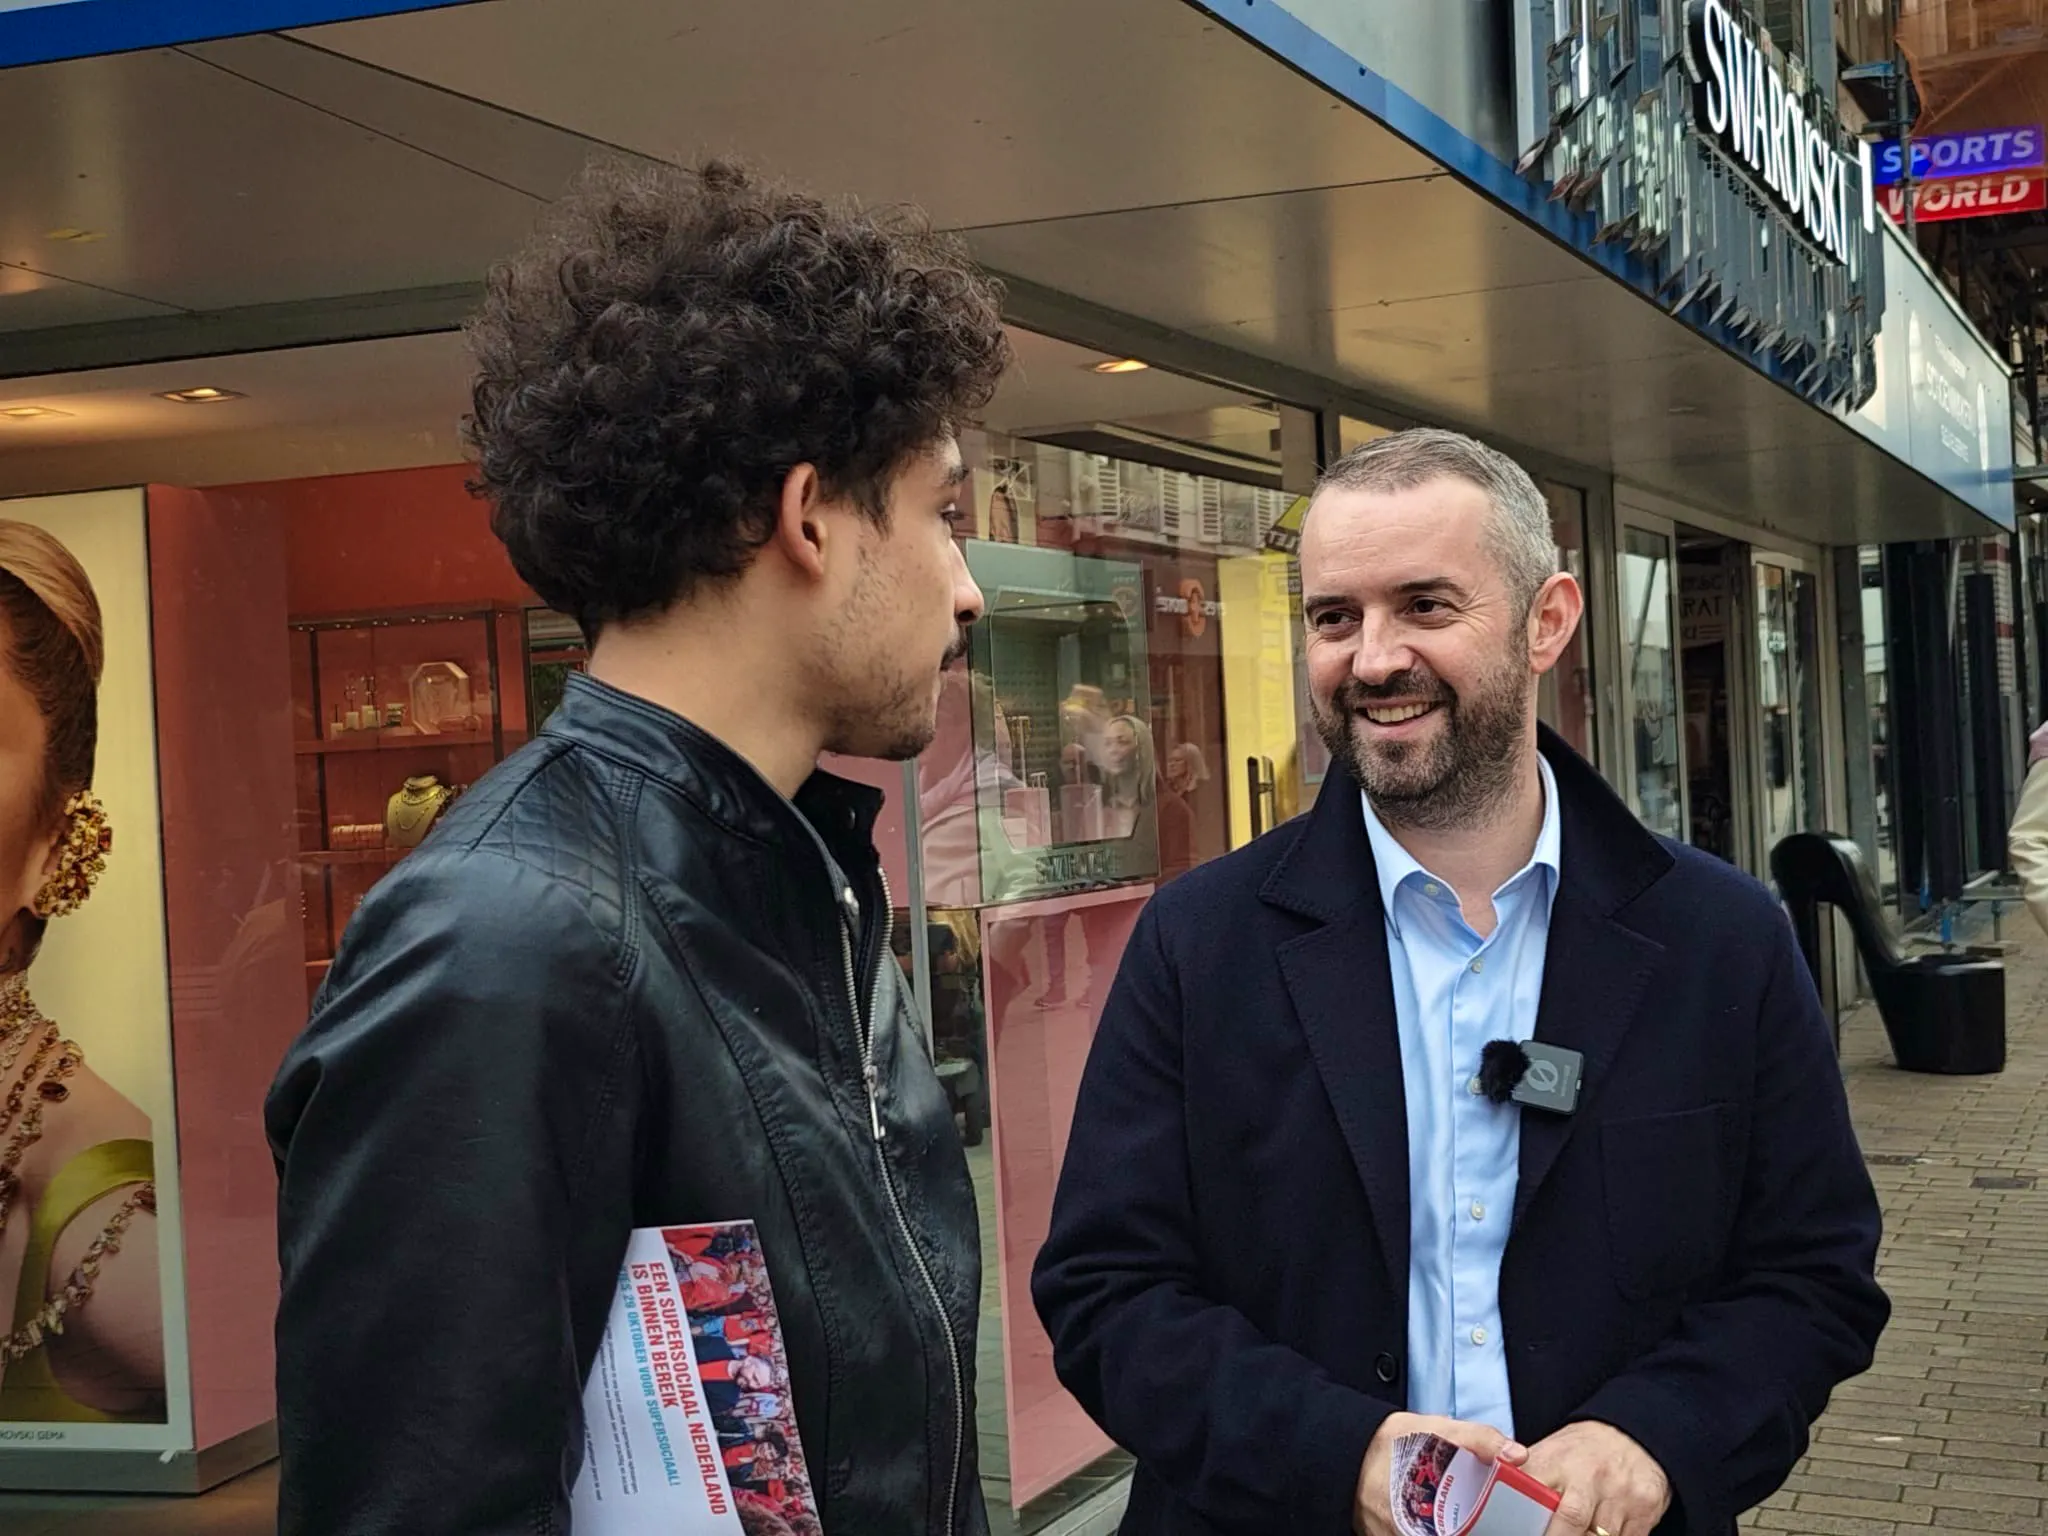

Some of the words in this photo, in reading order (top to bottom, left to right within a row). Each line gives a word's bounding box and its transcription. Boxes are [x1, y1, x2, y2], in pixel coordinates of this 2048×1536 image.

[1703, 0, 1849, 265] SWAROVSKI
[1881, 130, 2035, 173] SPORTS
[1888, 176, 2030, 215] WORLD
[631, 1263, 648, 1280] IS
[649, 1262, 672, 1293] EEN
[627, 1312, 647, 1363] OKTOBER
[636, 1284, 664, 1346] BINNEN
[639, 1366, 655, 1396] VOOR
[651, 1351, 679, 1408] BEREIK
[659, 1297, 701, 1419] SUPERSOCIAAL
[646, 1399, 681, 1486] SUPERSOCIAAL!
[688, 1422, 728, 1515] NEDERLAND
